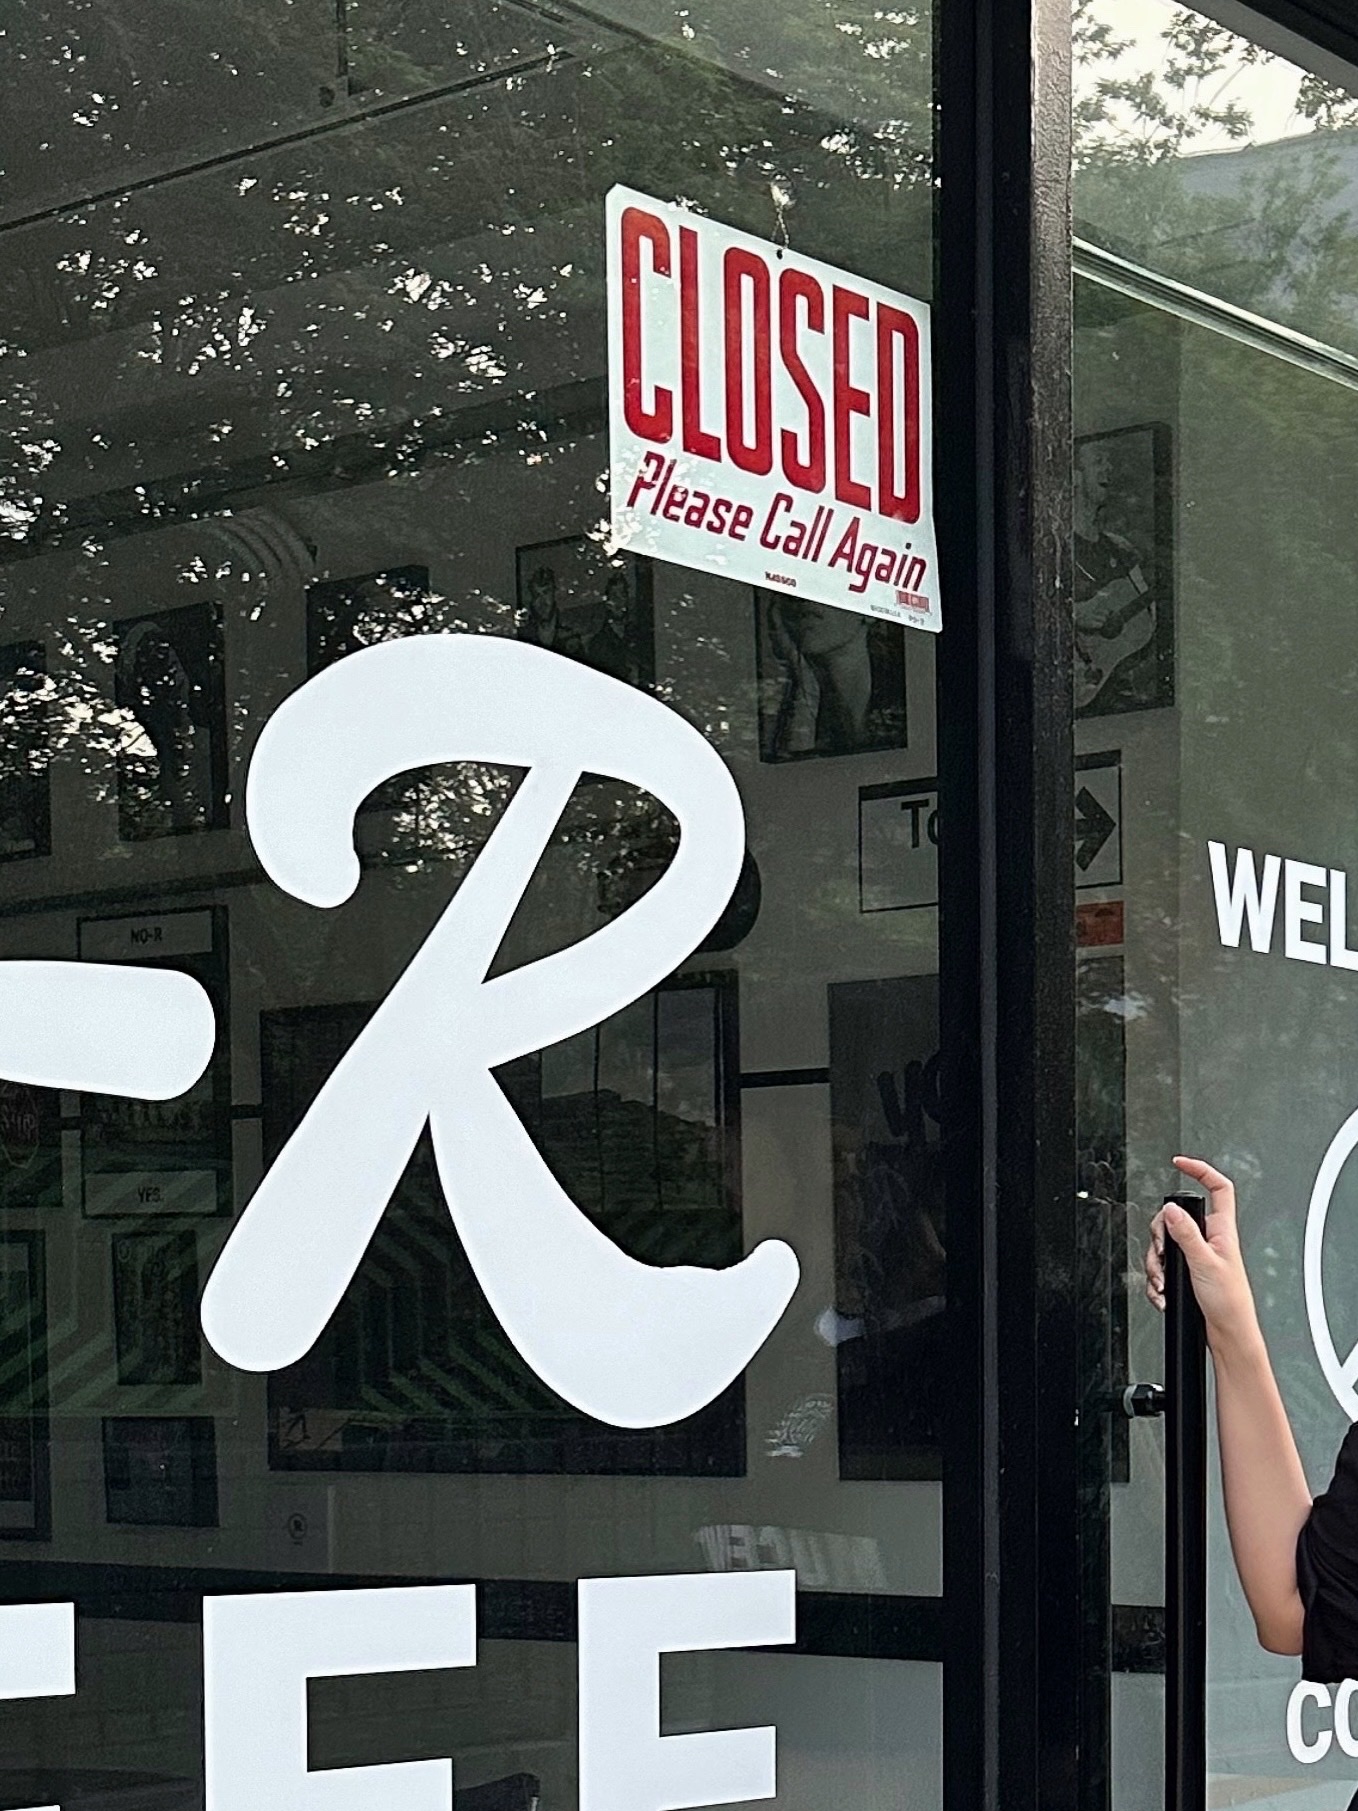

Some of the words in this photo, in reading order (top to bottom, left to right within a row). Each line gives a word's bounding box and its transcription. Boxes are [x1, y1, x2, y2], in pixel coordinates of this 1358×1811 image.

[622, 207, 920, 526] CLOSED
[626, 451, 753, 542] Please
[760, 492, 834, 564] Call
[828, 515, 928, 594] Again
